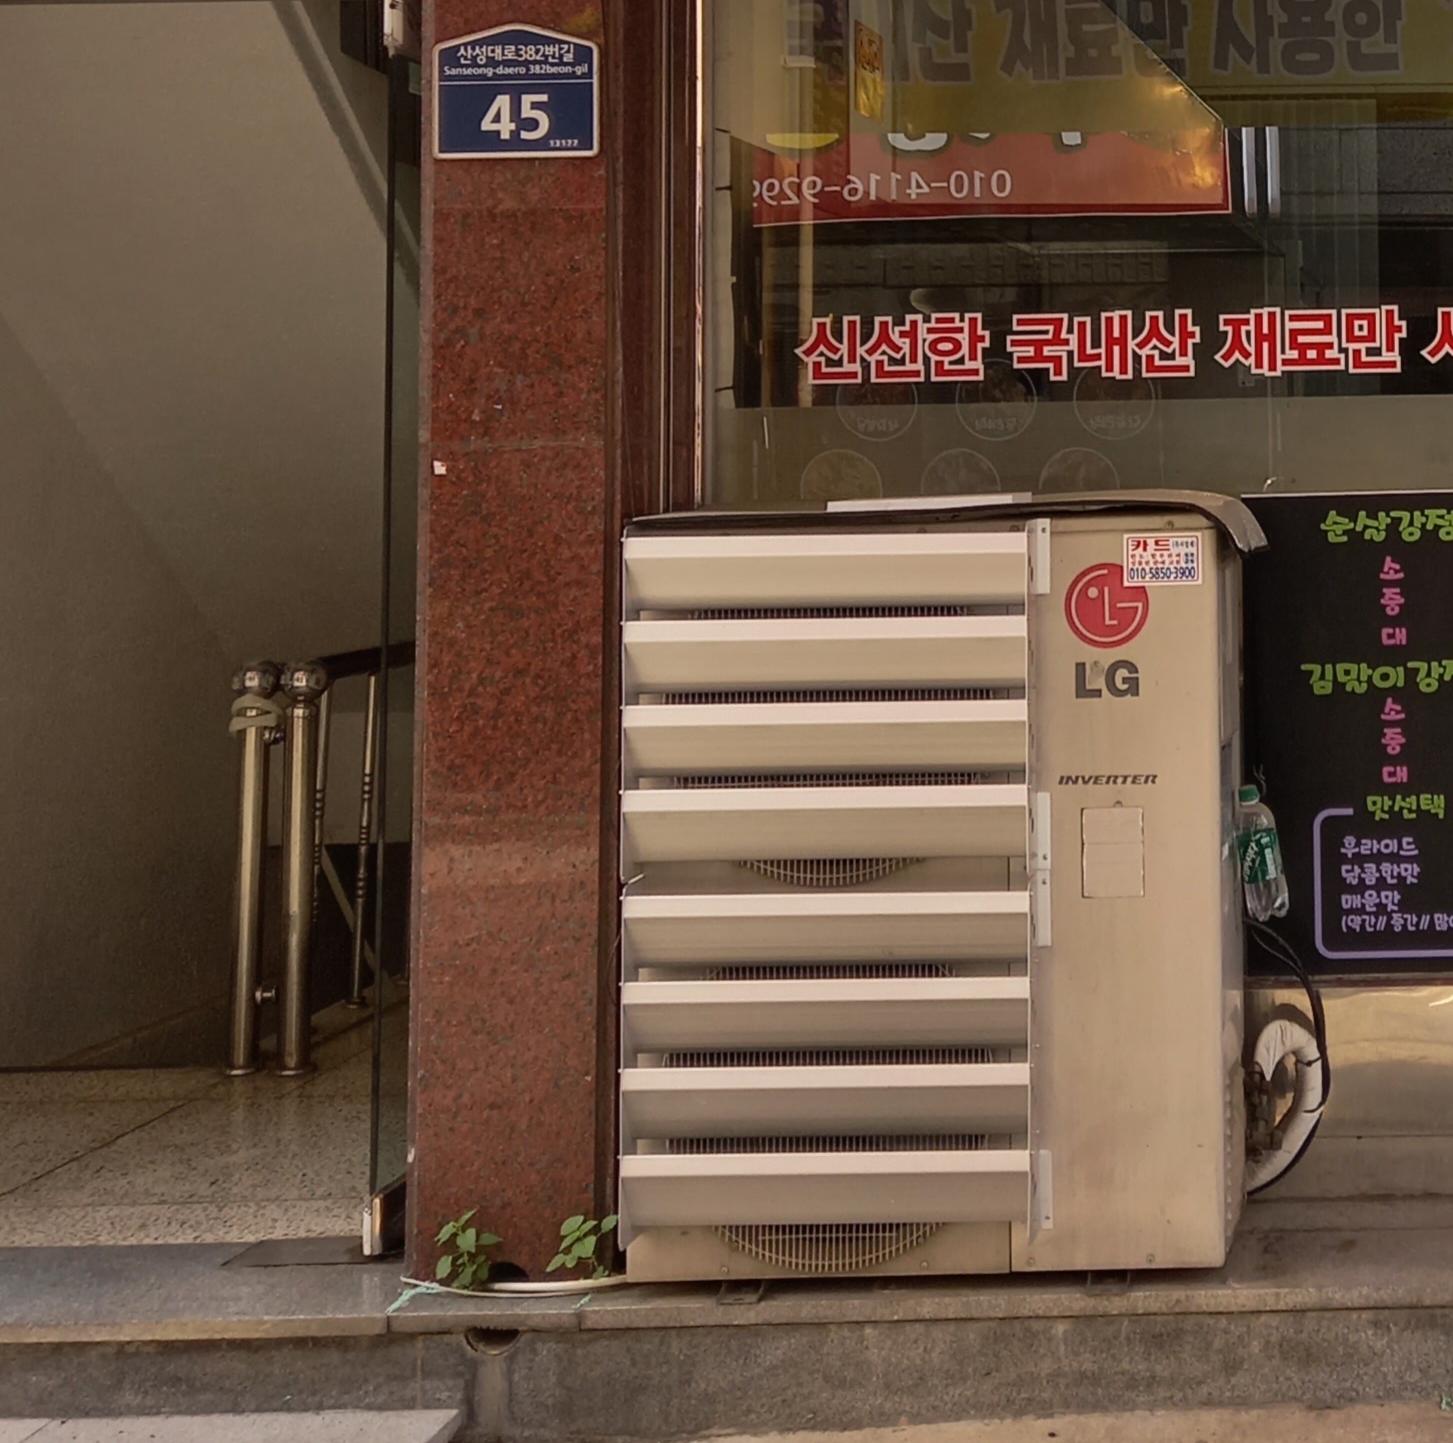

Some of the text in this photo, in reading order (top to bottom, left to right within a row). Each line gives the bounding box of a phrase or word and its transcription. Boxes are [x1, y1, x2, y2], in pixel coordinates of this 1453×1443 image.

[456, 43, 575, 65] 산성대로382번길
[443, 63, 589, 77] Sanseong-daero 382beon-gil
[480, 93, 551, 141] 45
[795, 312, 989, 385] 신선한
[1006, 307, 1201, 381] 국내산
[1215, 306, 1406, 377] 재료만
[1130, 539, 1171, 553] 카드
[1129, 566, 1196, 580] 010-5850-3900
[1380, 588, 1405, 616] 중
[1381, 627, 1407, 645] 대
[1075, 660, 1140, 699] LG
[1381, 728, 1406, 755] 중
[1058, 774, 1158, 786] INVERTER
[1382, 766, 1408, 783] 대
[1366, 794, 1446, 821] 맛선택
[1340, 835, 1419, 858] 후라이드
[1341, 862, 1421, 885] 달콤한맛
[1341, 890, 1401, 912] 매운맛
